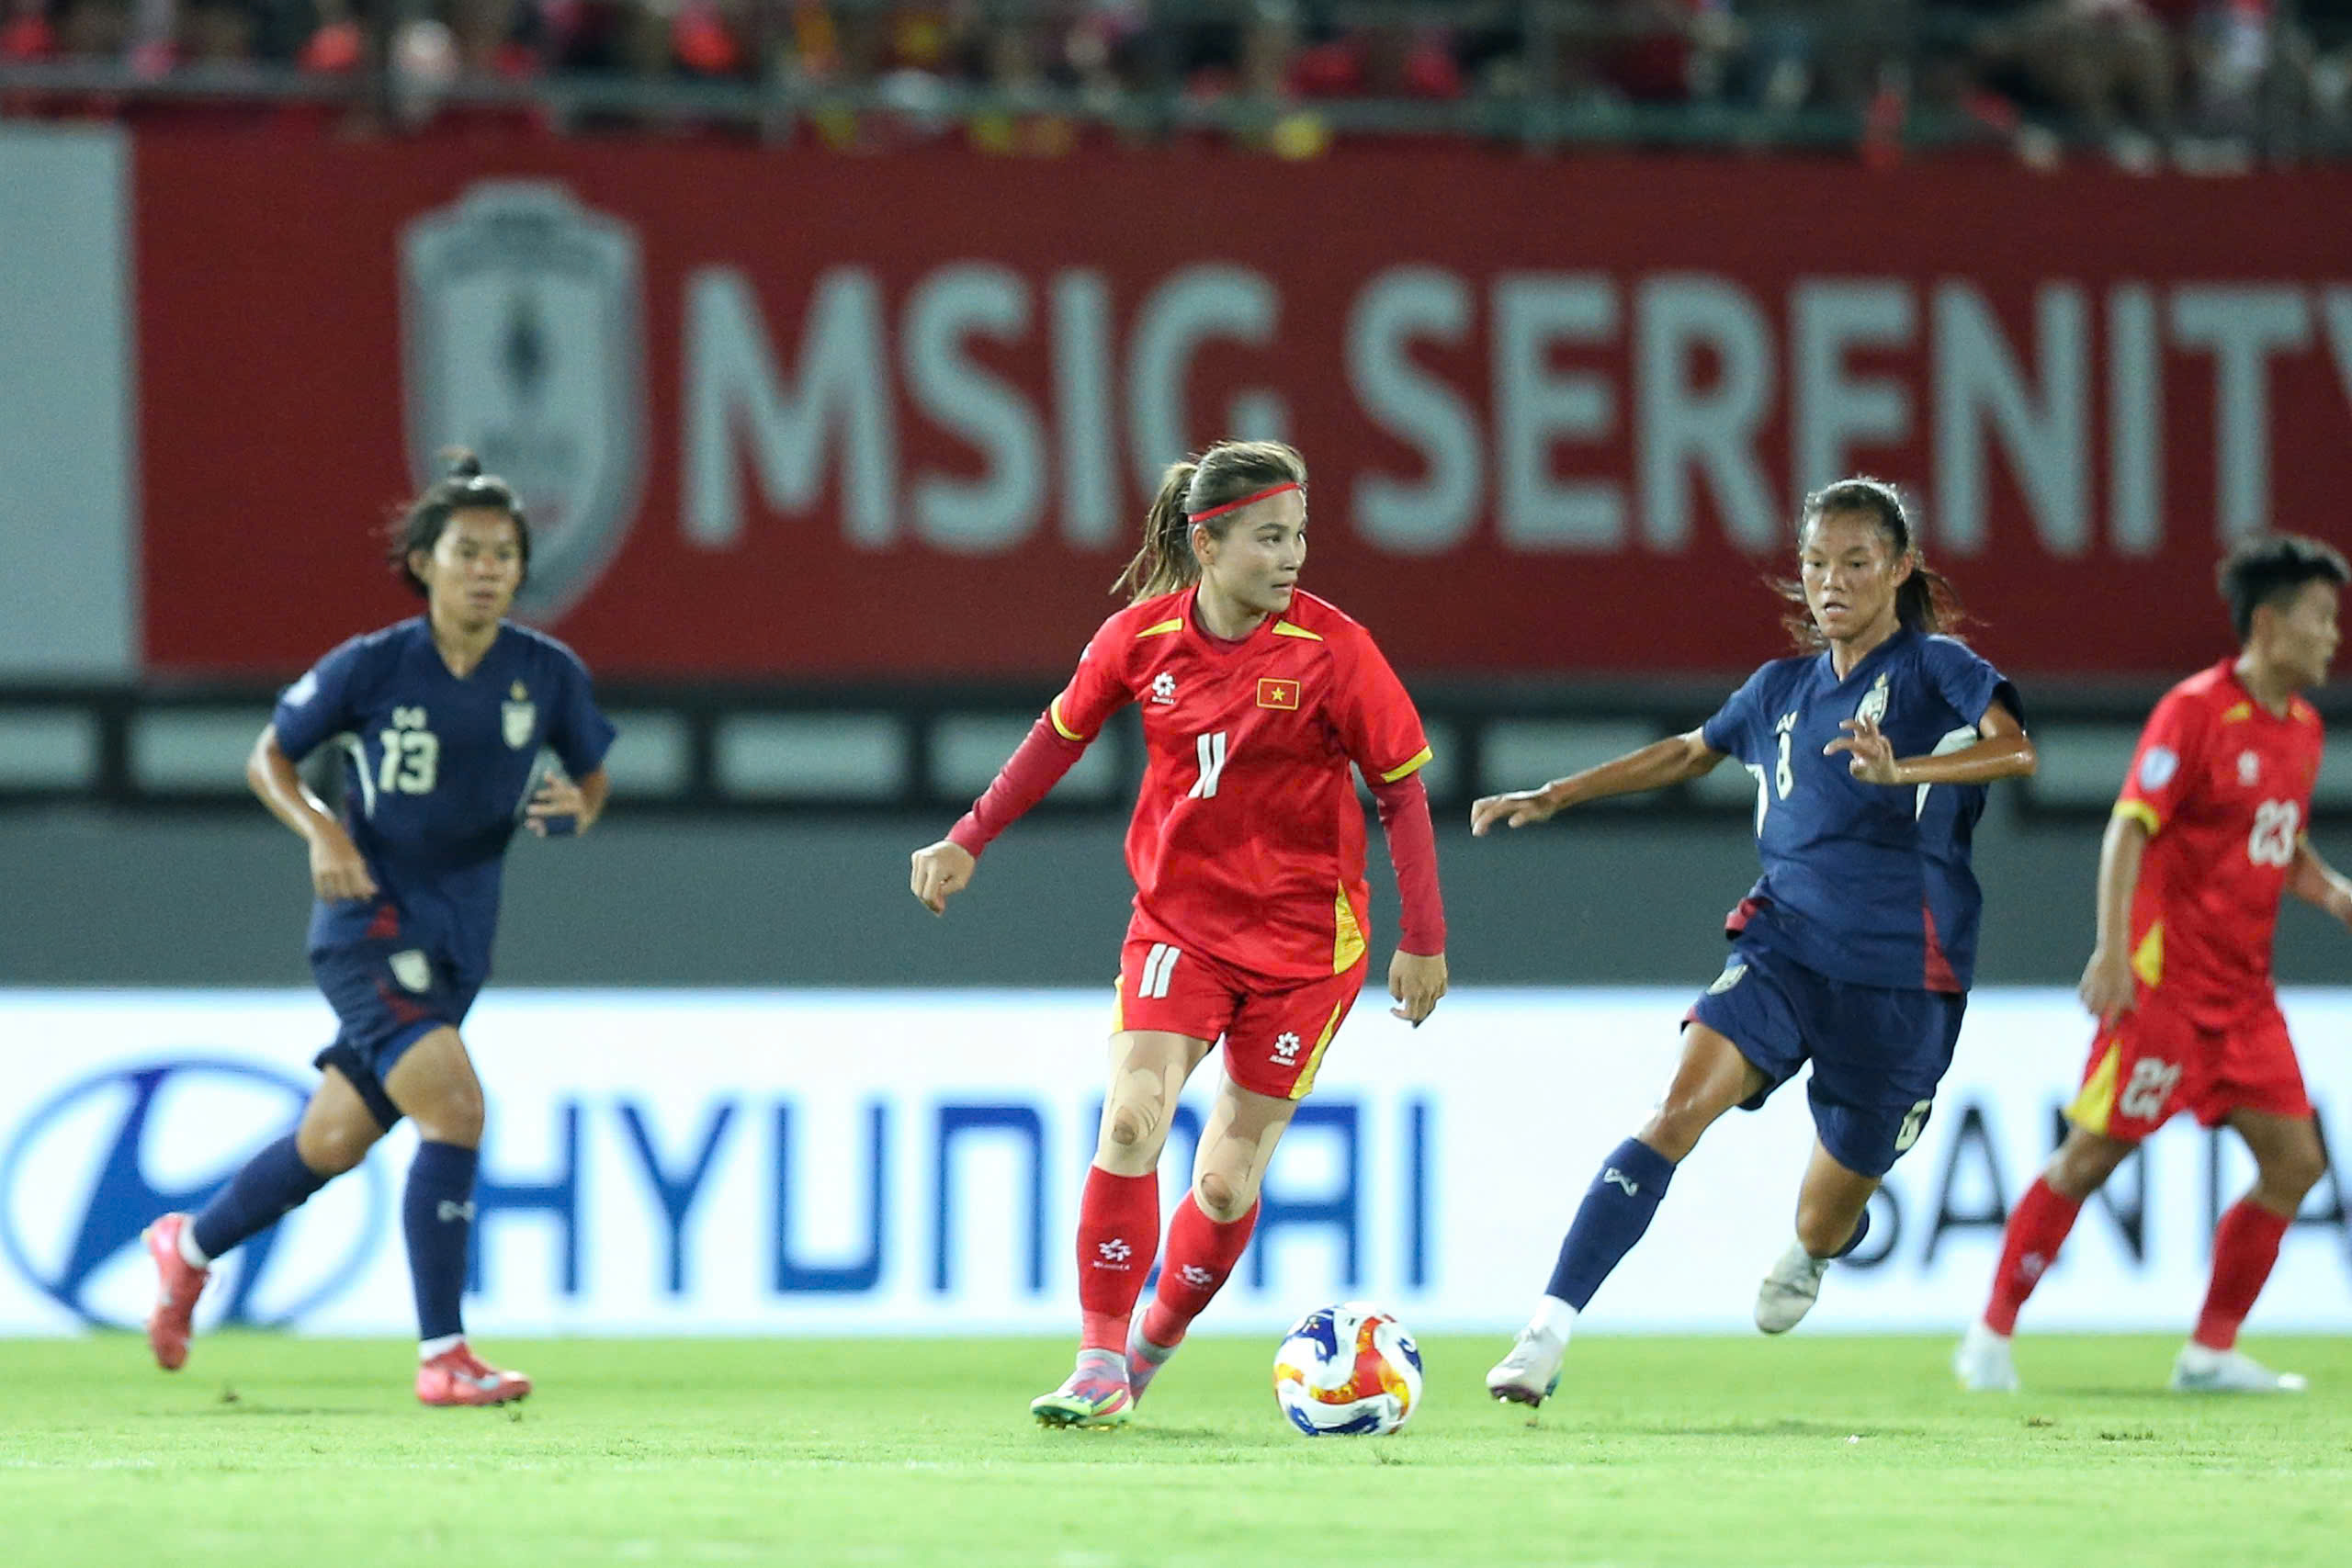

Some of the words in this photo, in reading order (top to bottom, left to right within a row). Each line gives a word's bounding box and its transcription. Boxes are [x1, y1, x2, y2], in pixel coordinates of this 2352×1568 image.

[683, 264, 1288, 549] MSIG
[1345, 265, 2352, 555] SERENIT
[379, 728, 438, 795] 13
[1188, 731, 1227, 799] 11
[2248, 799, 2300, 867] 23
[1137, 942, 1182, 998] 11
